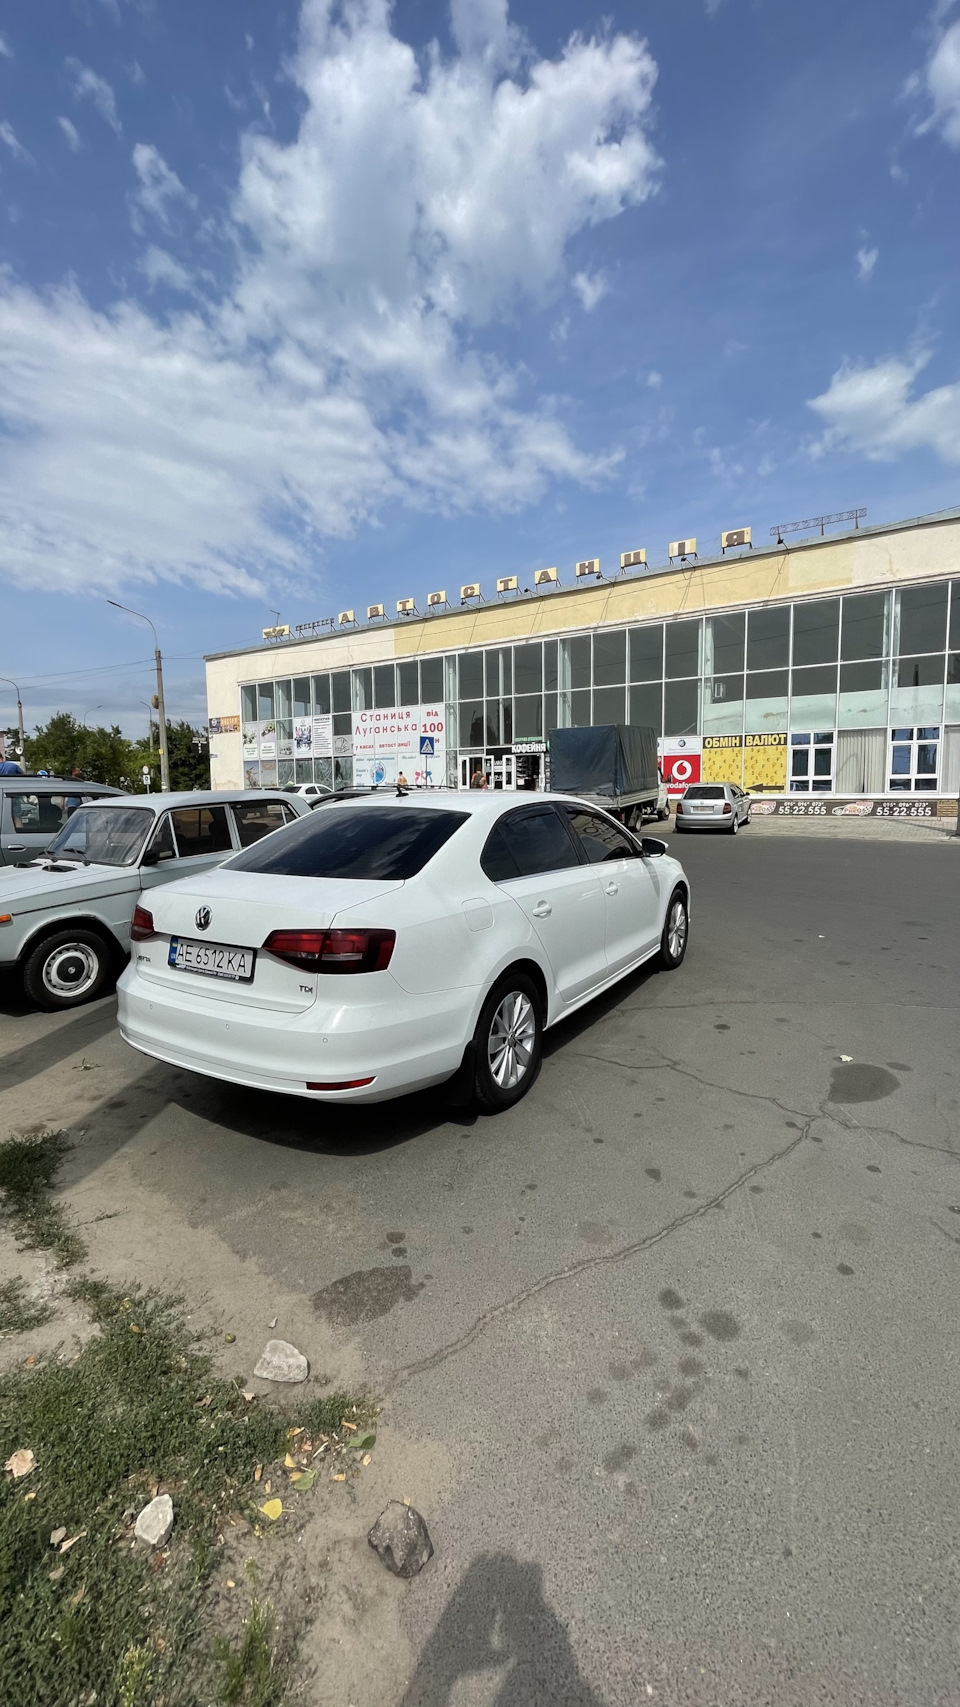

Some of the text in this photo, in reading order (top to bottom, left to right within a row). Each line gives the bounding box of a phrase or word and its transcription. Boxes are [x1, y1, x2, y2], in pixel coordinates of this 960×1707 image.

[340, 529, 746, 623] АВТОСТАНЦІЯ
[360, 709, 439, 723] Станиця від
[355, 722, 444, 737] Луганська 100
[511, 742, 546, 753] КОФЕЙНЯ
[705, 734, 787, 748] ОБМІН ВАЛЮТ
[665, 781, 692, 789] vodafo
[176, 943, 194, 963] AE
[195, 946, 225, 969] 6512
[226, 951, 246, 973] KA
